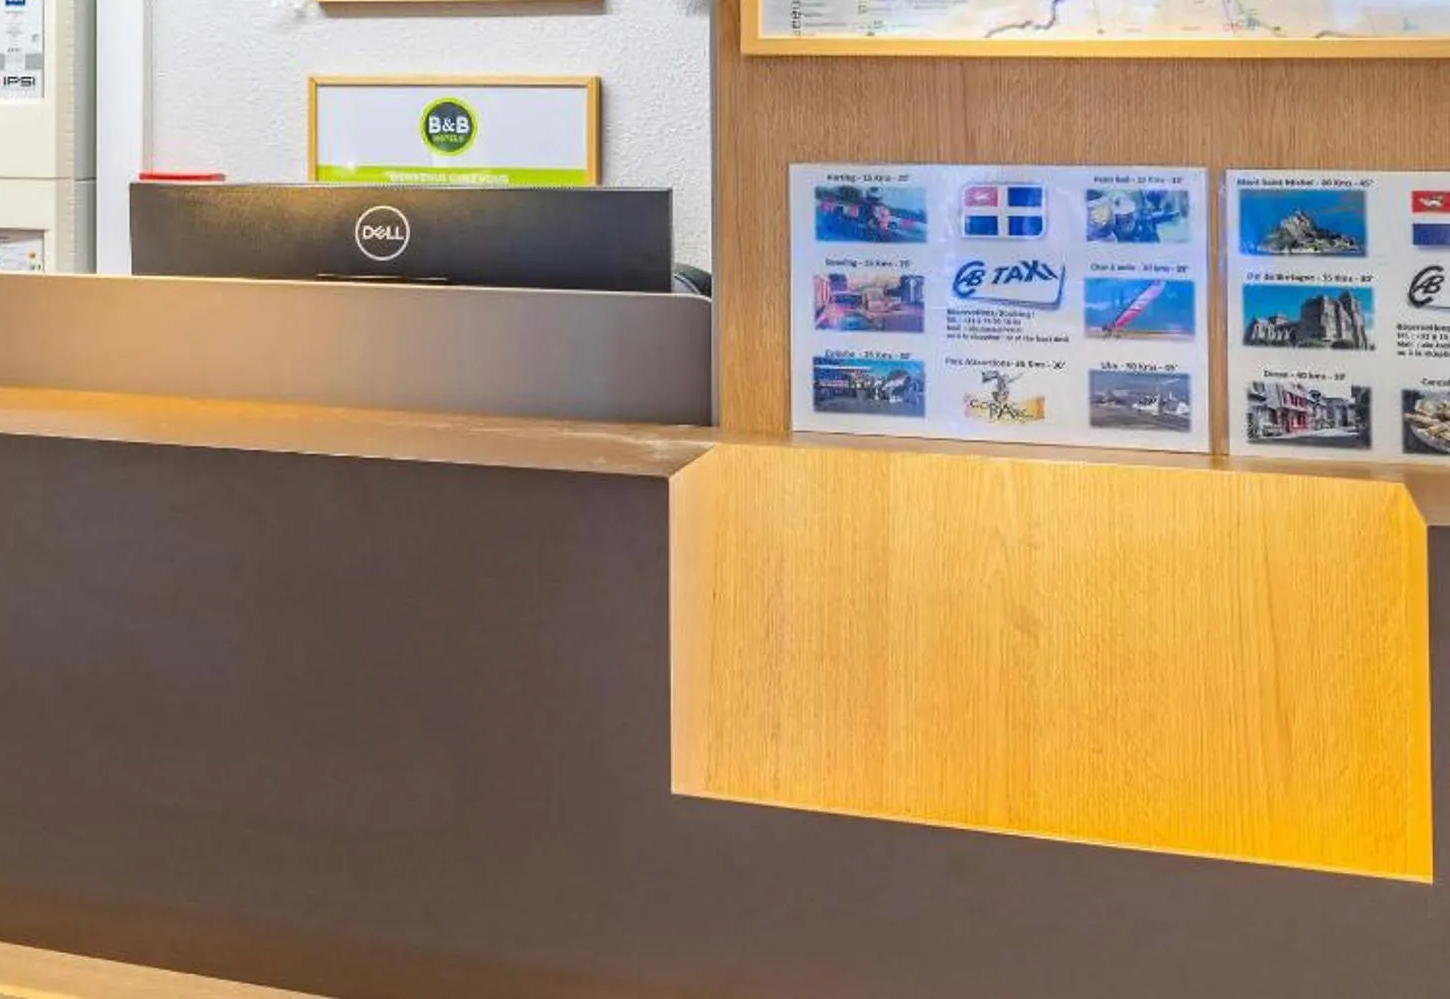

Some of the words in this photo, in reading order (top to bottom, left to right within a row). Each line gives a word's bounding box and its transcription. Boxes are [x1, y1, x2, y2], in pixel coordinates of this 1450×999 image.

[2, 76, 36, 88] IPSI
[428, 116, 470, 134] B&B
[362, 225, 405, 240] DELL
